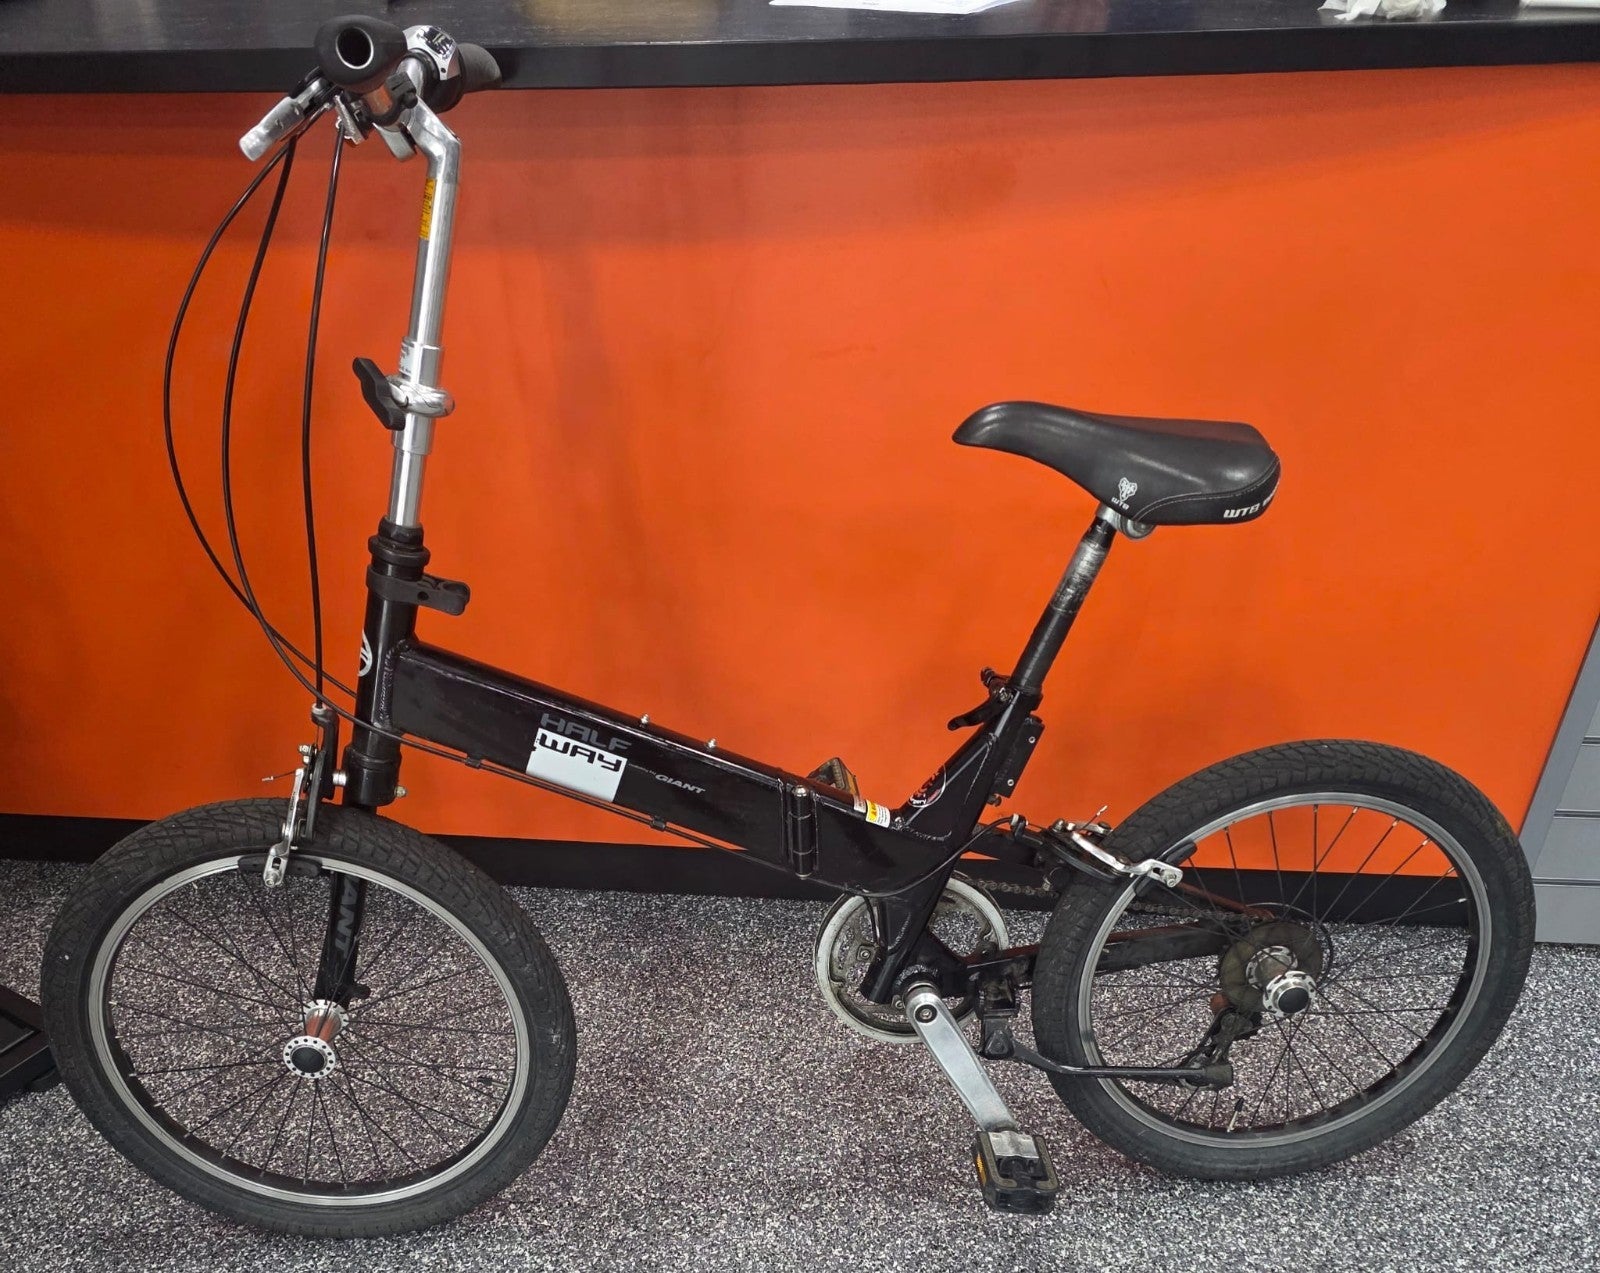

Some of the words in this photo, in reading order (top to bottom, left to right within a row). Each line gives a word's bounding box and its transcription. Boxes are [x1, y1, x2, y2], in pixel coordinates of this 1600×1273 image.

[1111, 497, 1130, 511] WTB
[1223, 503, 1260, 518] WTB
[541, 713, 632, 751] HALF
[538, 732, 623, 772] WAY
[656, 774, 706, 794] GIANT
